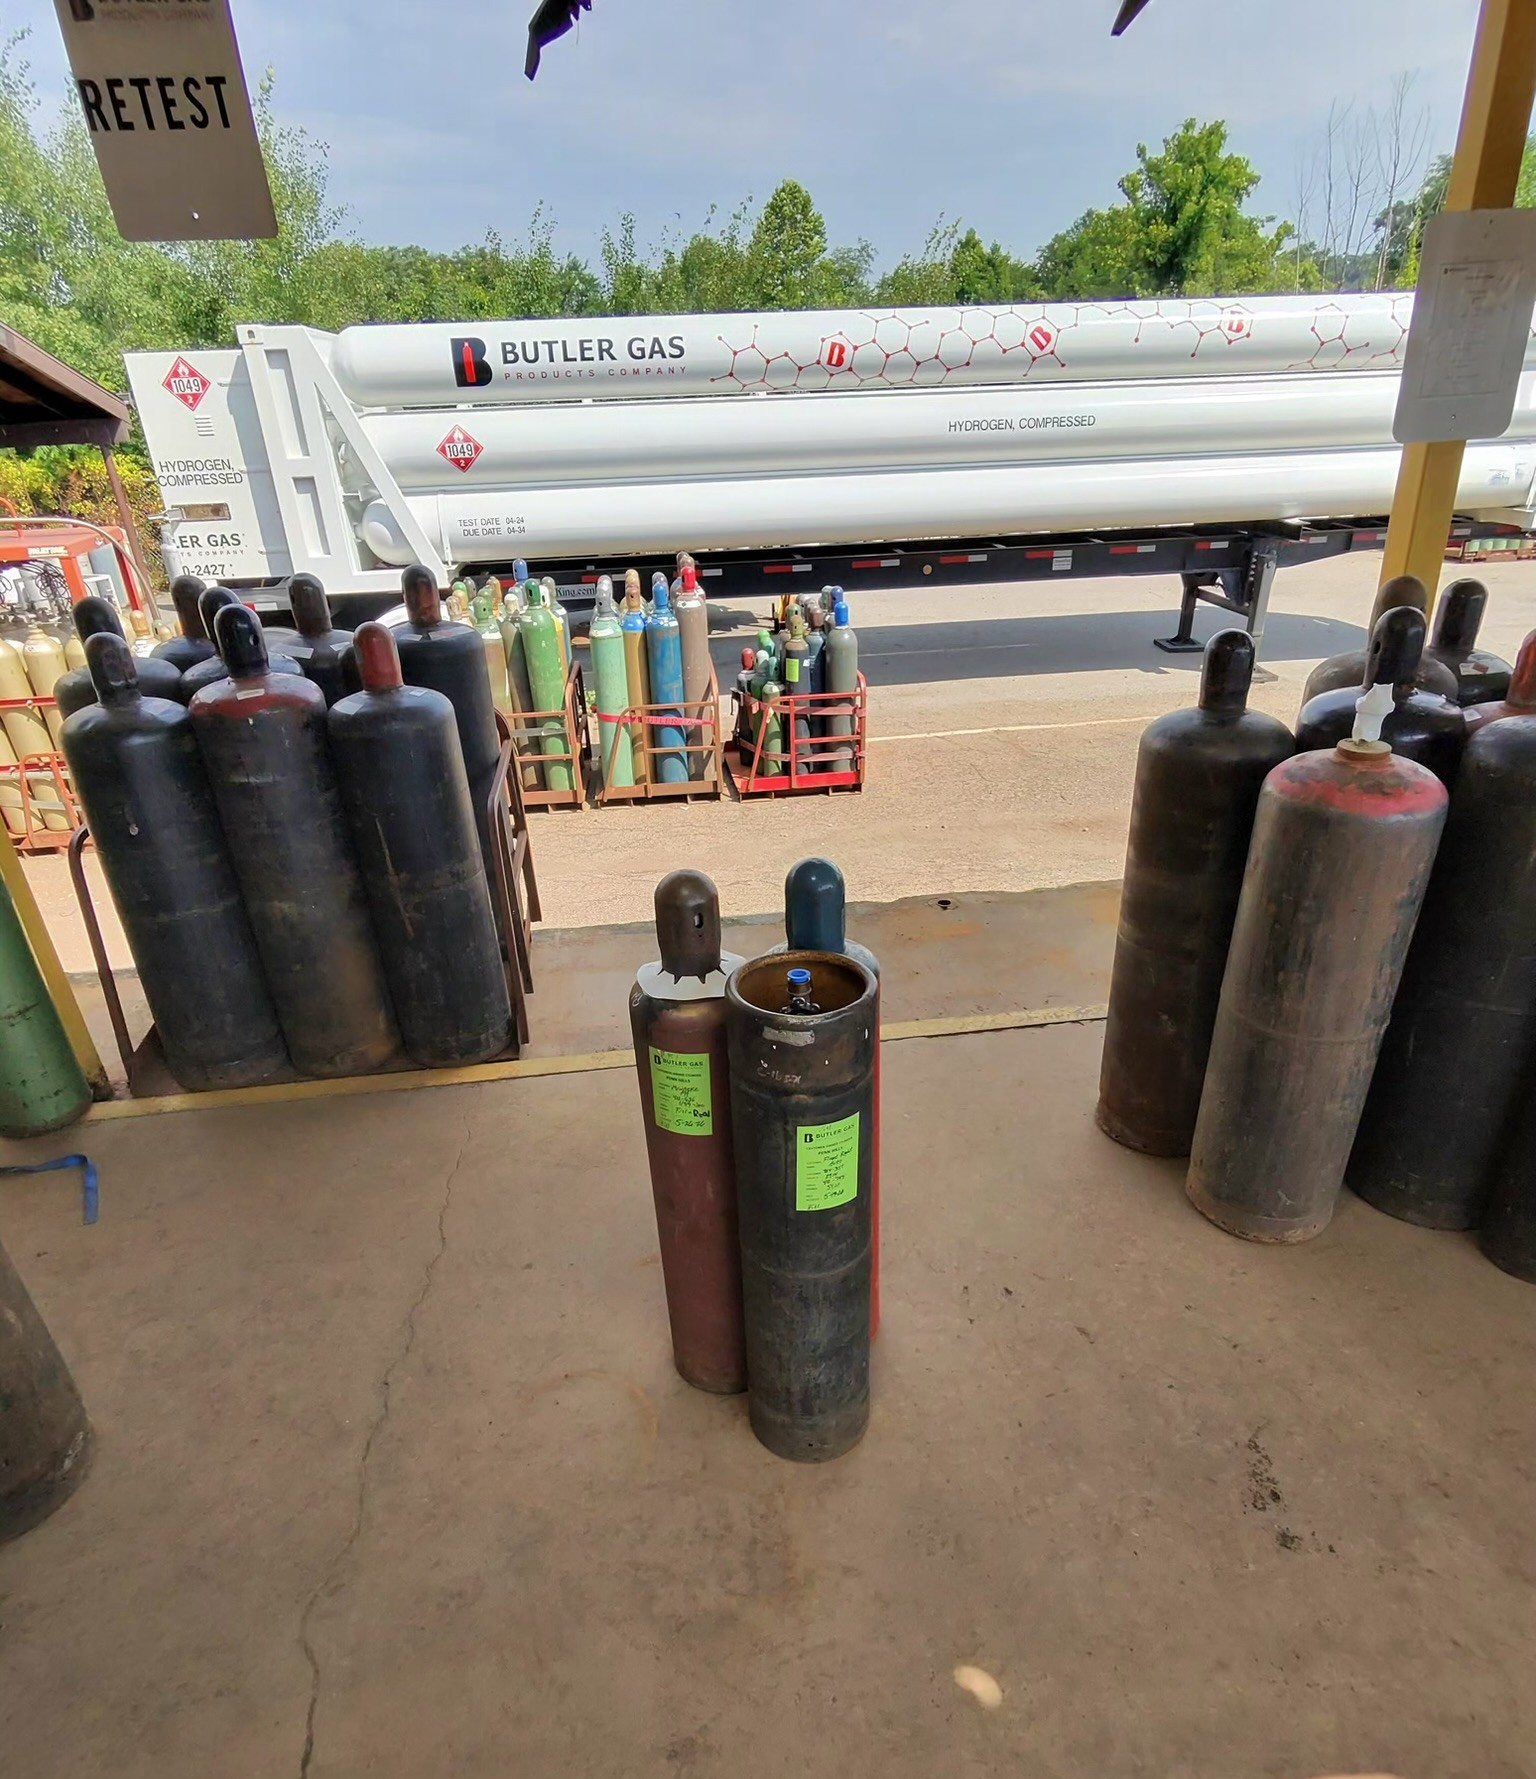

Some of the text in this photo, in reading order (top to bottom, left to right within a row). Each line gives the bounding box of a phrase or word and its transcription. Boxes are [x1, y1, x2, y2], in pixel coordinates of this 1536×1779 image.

[77, 75, 231, 131] RETEST
[500, 335, 685, 365] BUTLER GAS
[504, 366, 687, 380] PRODUCTS COMPANY
[172, 378, 202, 393] 1049
[187, 395, 194, 404] 2
[948, 415, 1096, 432] HYDROGEN, COMPRESSED
[447, 442, 474, 458] 1049
[159, 458, 235, 473] HYDROGEN,
[459, 459, 466, 467] 2
[157, 472, 243, 487] COMPRESSED
[458, 516, 524, 527] TEST DATE 04-24
[463, 526, 526, 537] DUE DATE 04-34
[206, 533, 242, 547] GAS
[198, 549, 244, 557] COMPANY
[663, 1059, 688, 1067] BUTLER
[815, 1129, 842, 1139] BUTLER
[843, 1124, 855, 1132] GAS
